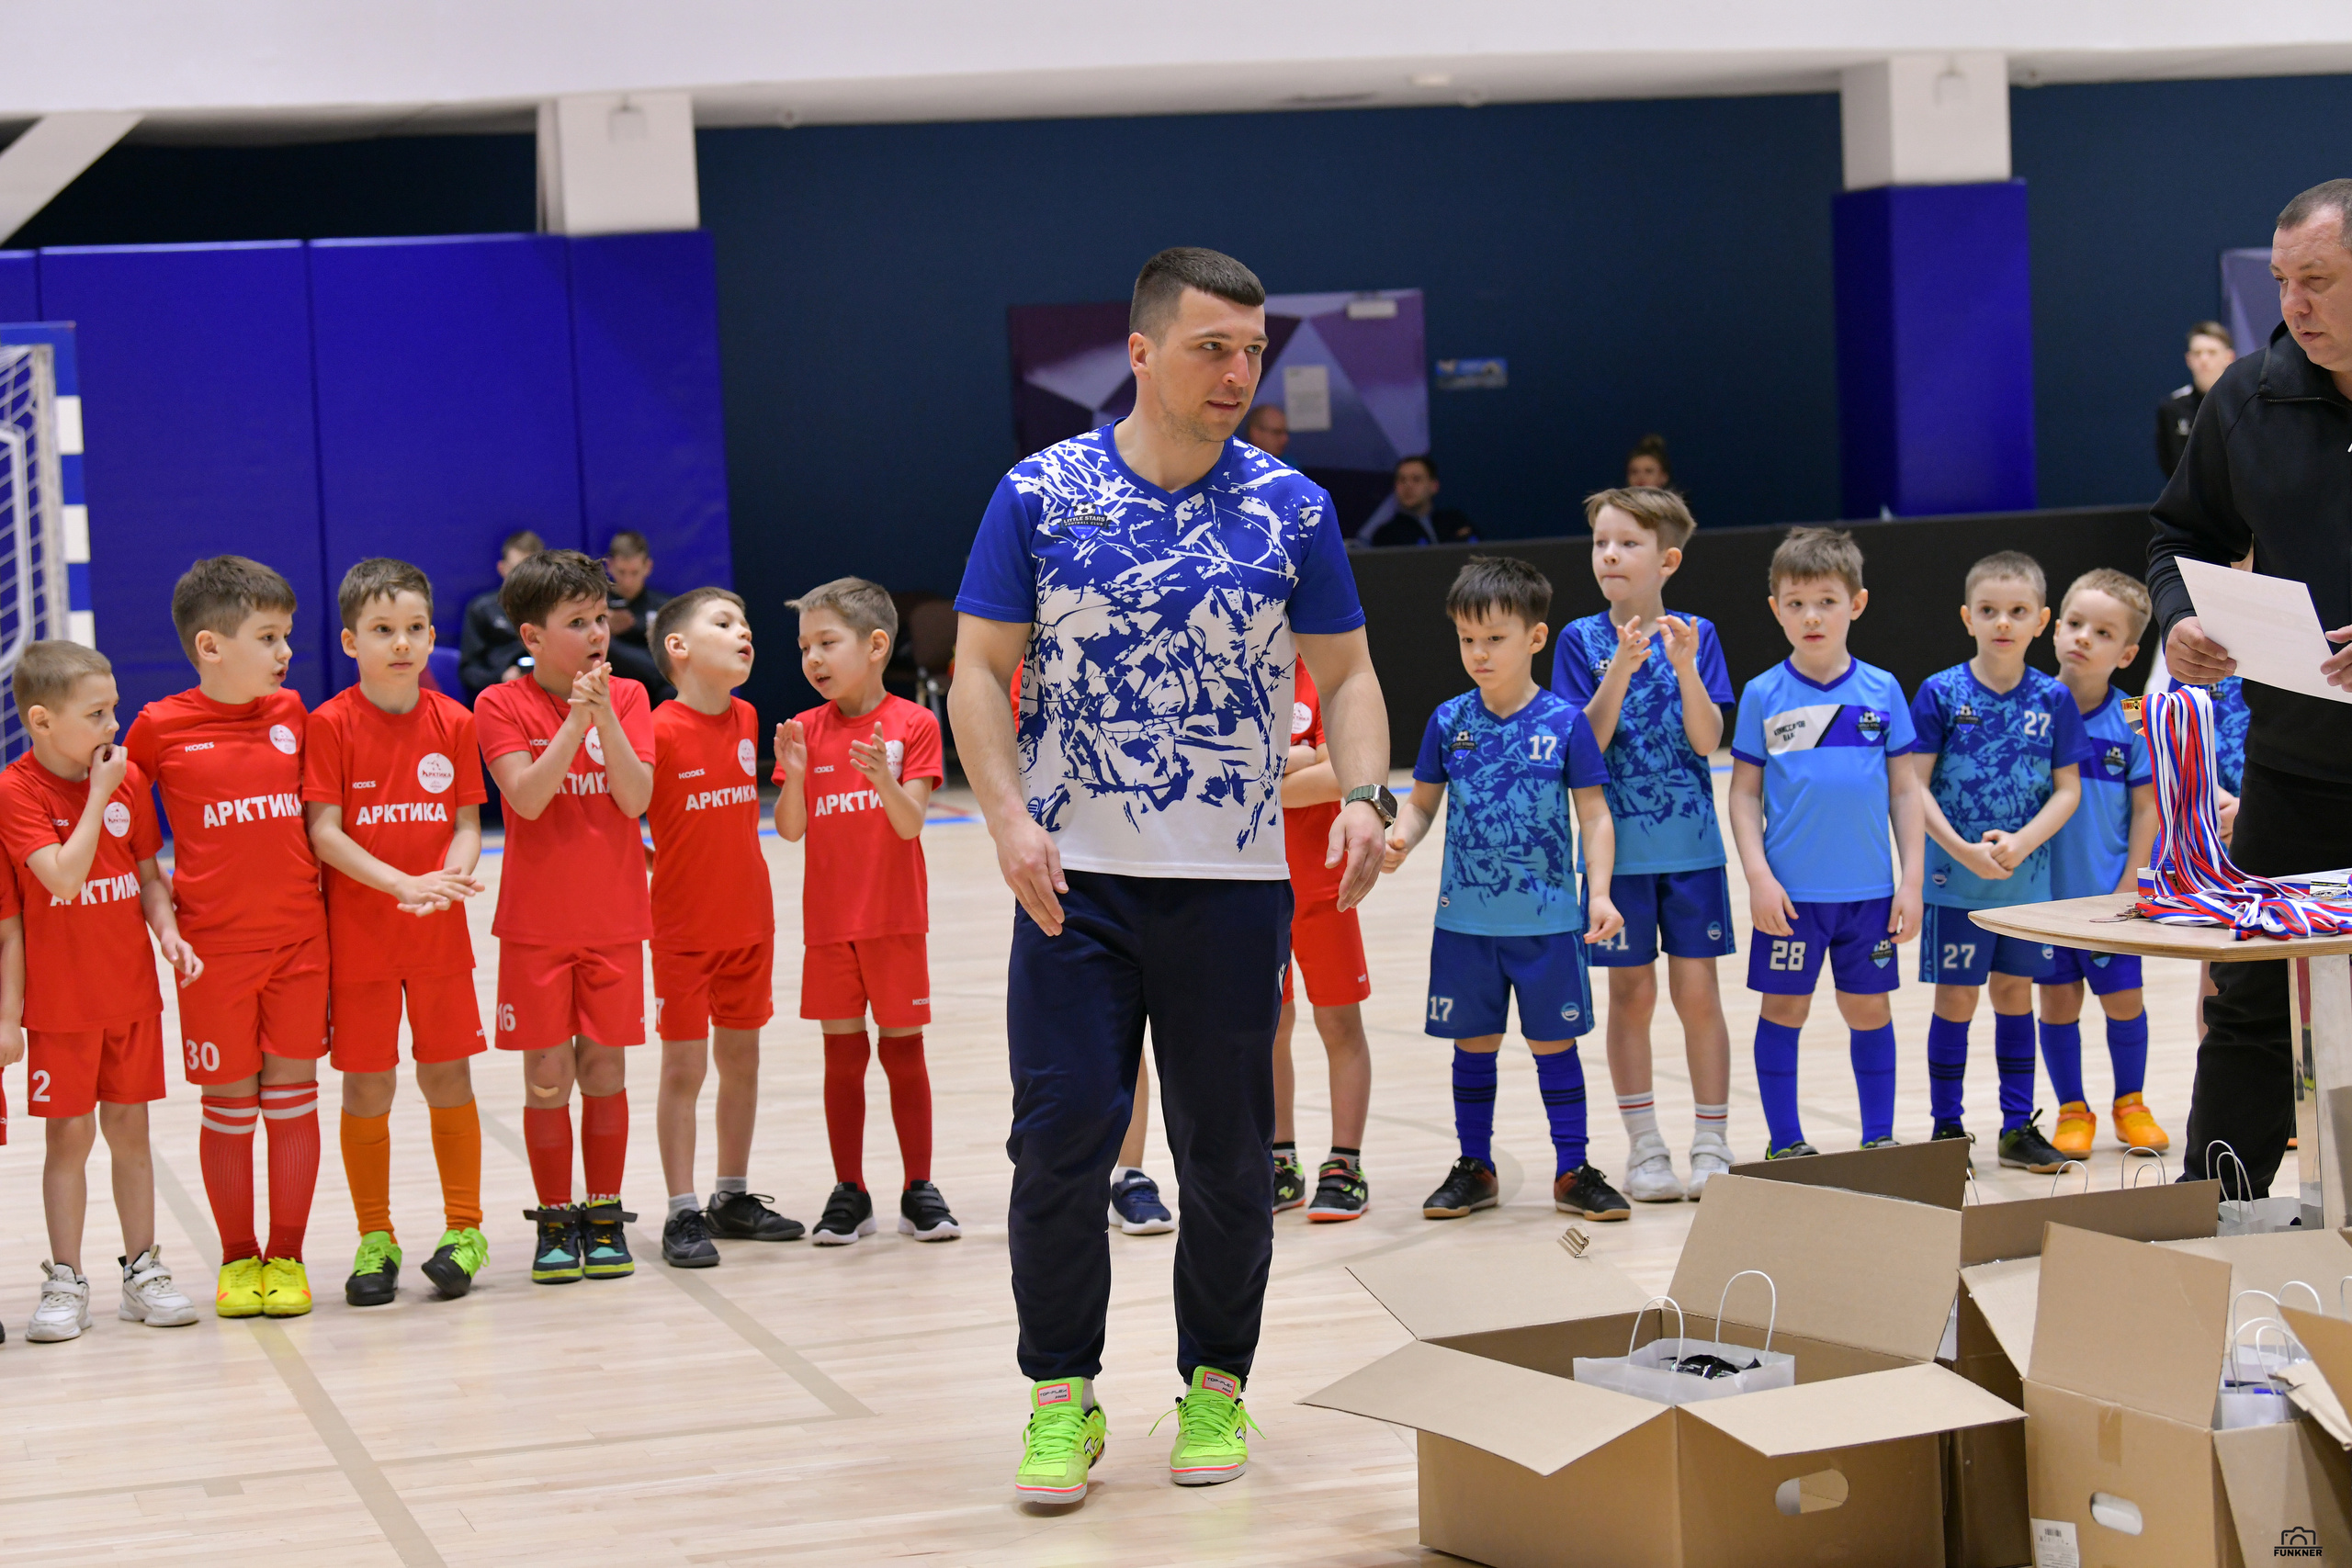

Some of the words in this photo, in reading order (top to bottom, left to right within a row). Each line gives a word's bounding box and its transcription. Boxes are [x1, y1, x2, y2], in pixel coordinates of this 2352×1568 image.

[2024, 710, 2052, 737] 27
[185, 741, 214, 752] KODES
[1529, 735, 1557, 761] 17
[352, 781, 376, 789] KODES
[555, 772, 610, 796] ТИК
[678, 768, 706, 780] KODES
[203, 793, 302, 829] АРКТИКА
[684, 784, 757, 811] АРКТИКА
[814, 789, 884, 818] АРКТИ
[356, 802, 448, 826] АРКТИКА
[50, 871, 141, 907] КТИА
[1769, 939, 1807, 972] 28
[1942, 943, 1976, 969] 27
[496, 1002, 516, 1032] 16
[1430, 996, 1453, 1021] 17
[186, 1039, 220, 1073] 30
[32, 1069, 51, 1102] 2
